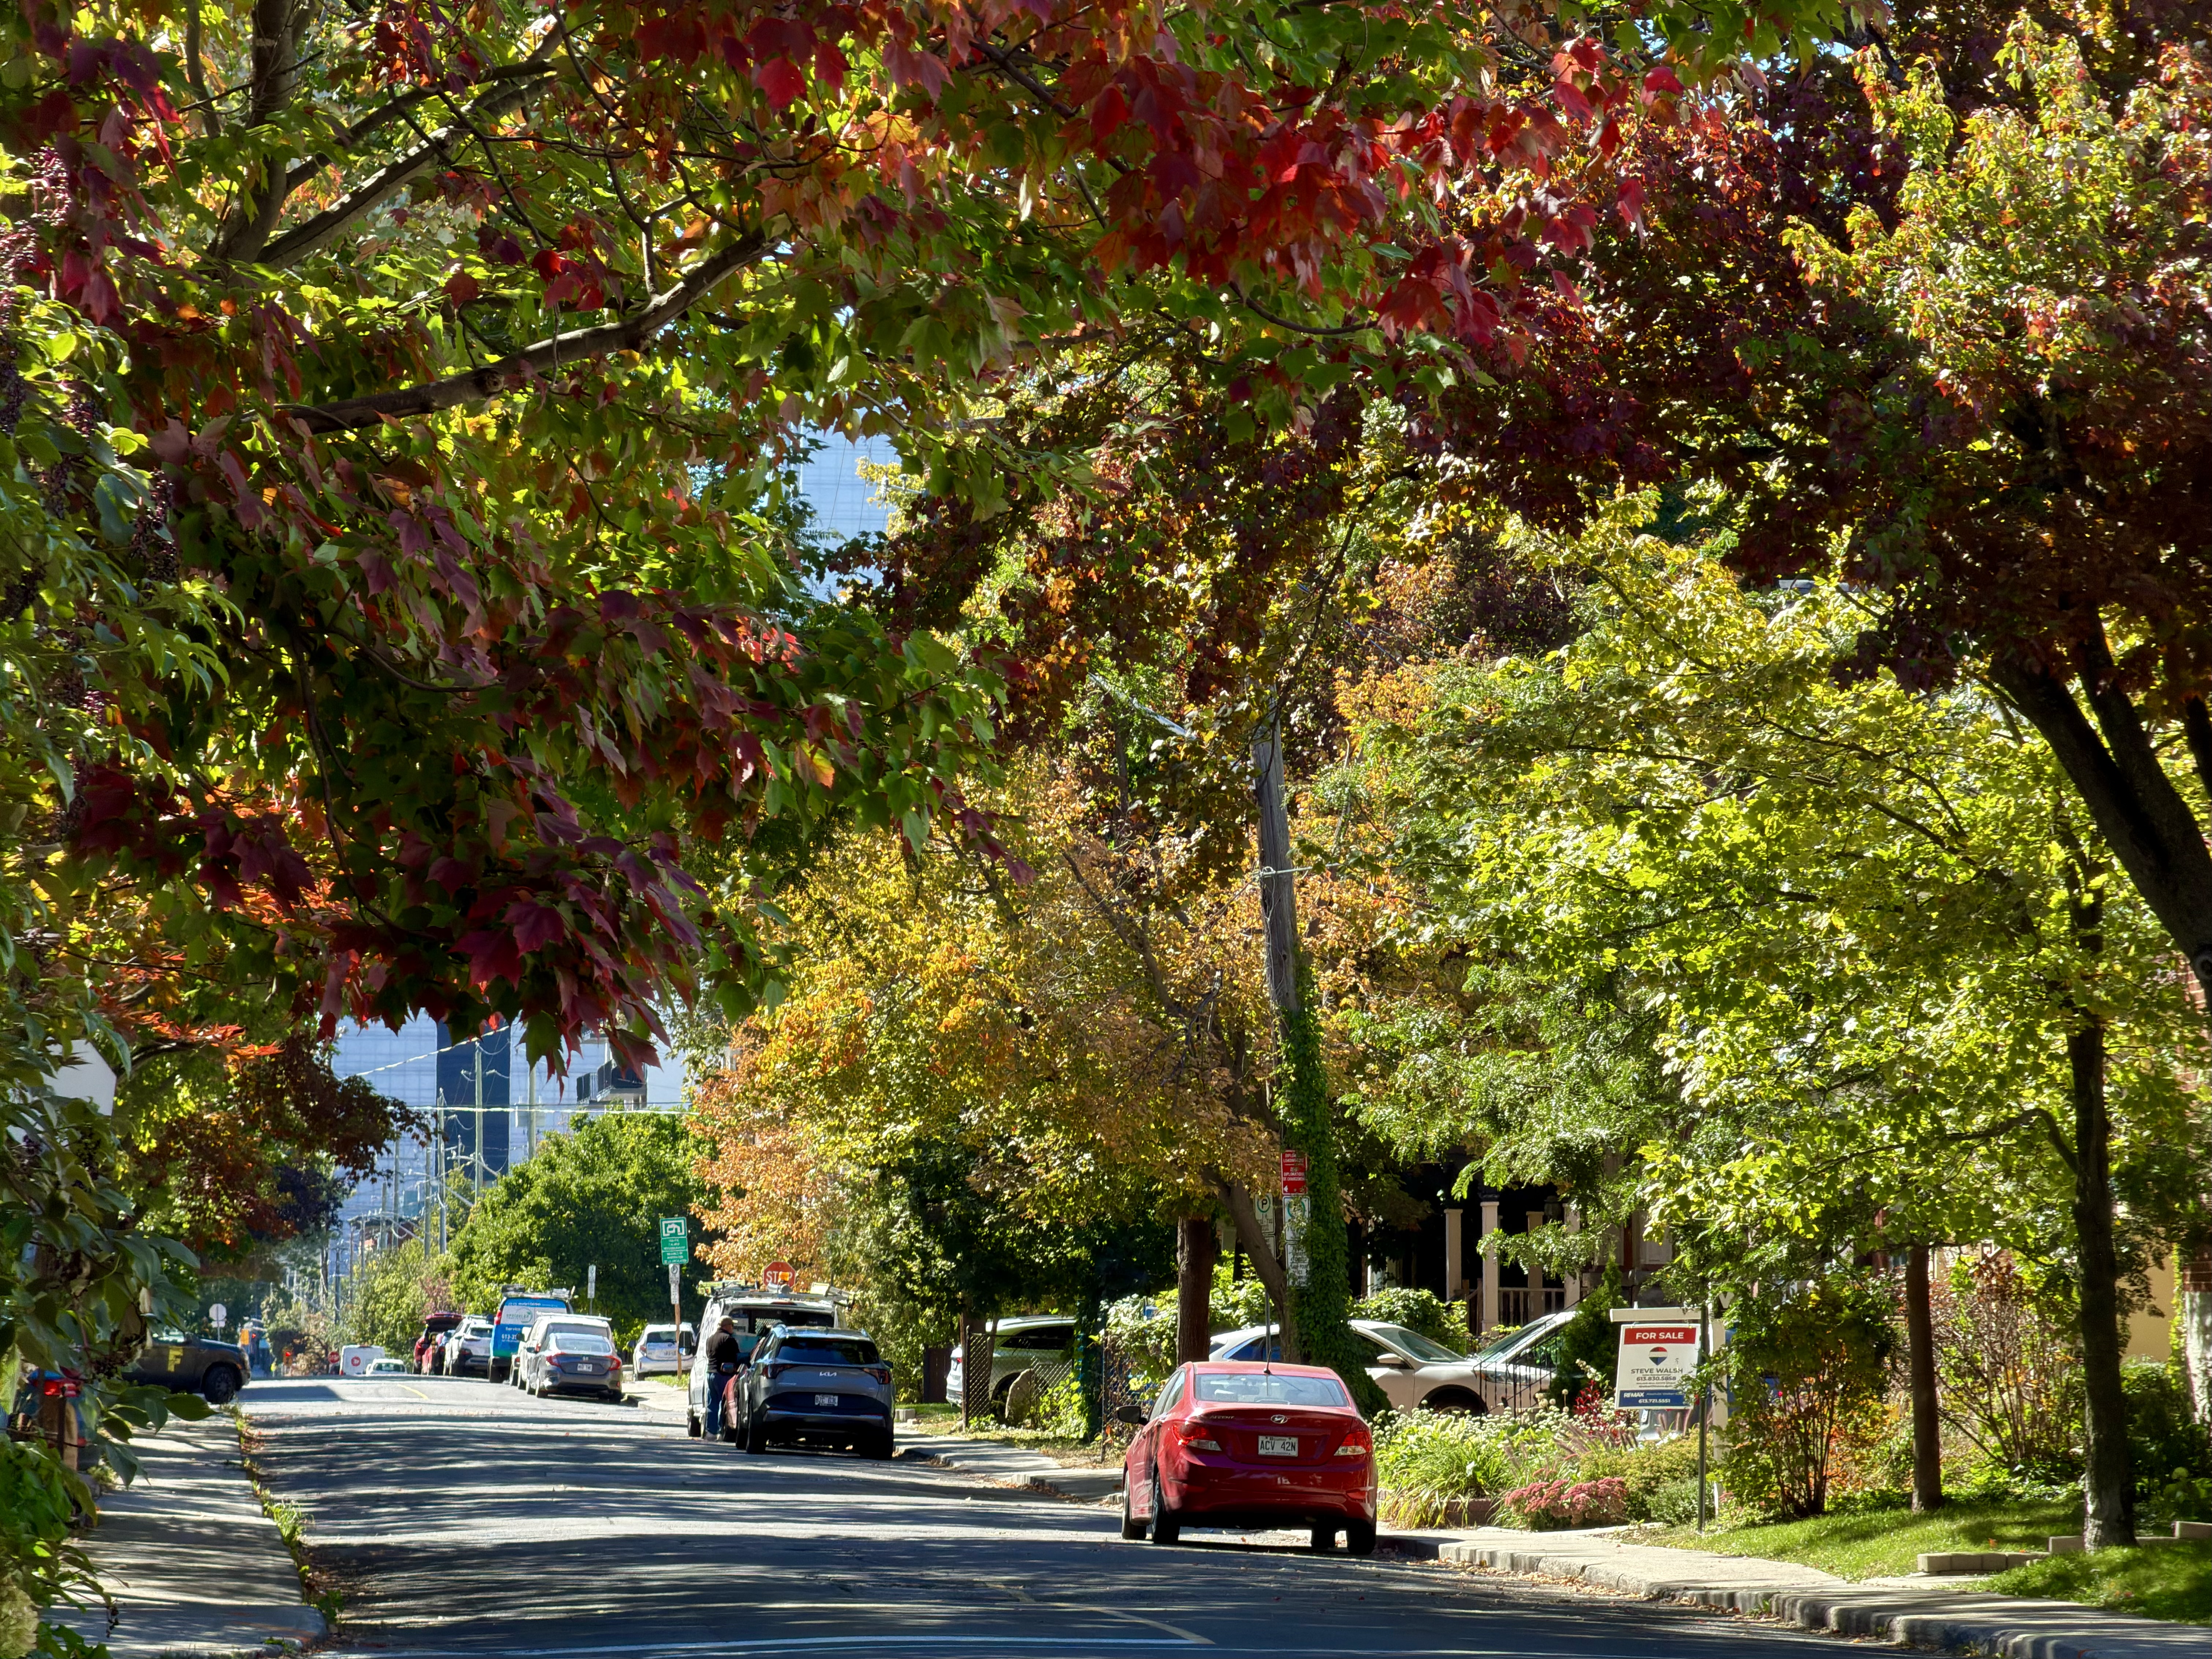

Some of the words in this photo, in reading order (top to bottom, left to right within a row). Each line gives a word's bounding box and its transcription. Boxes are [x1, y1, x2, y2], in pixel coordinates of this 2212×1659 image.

[766, 1271, 793, 1283] STP
[168, 1346, 183, 1372] F
[1260, 1440, 1275, 1451] ACV
[1281, 1441, 1296, 1451] 42N
